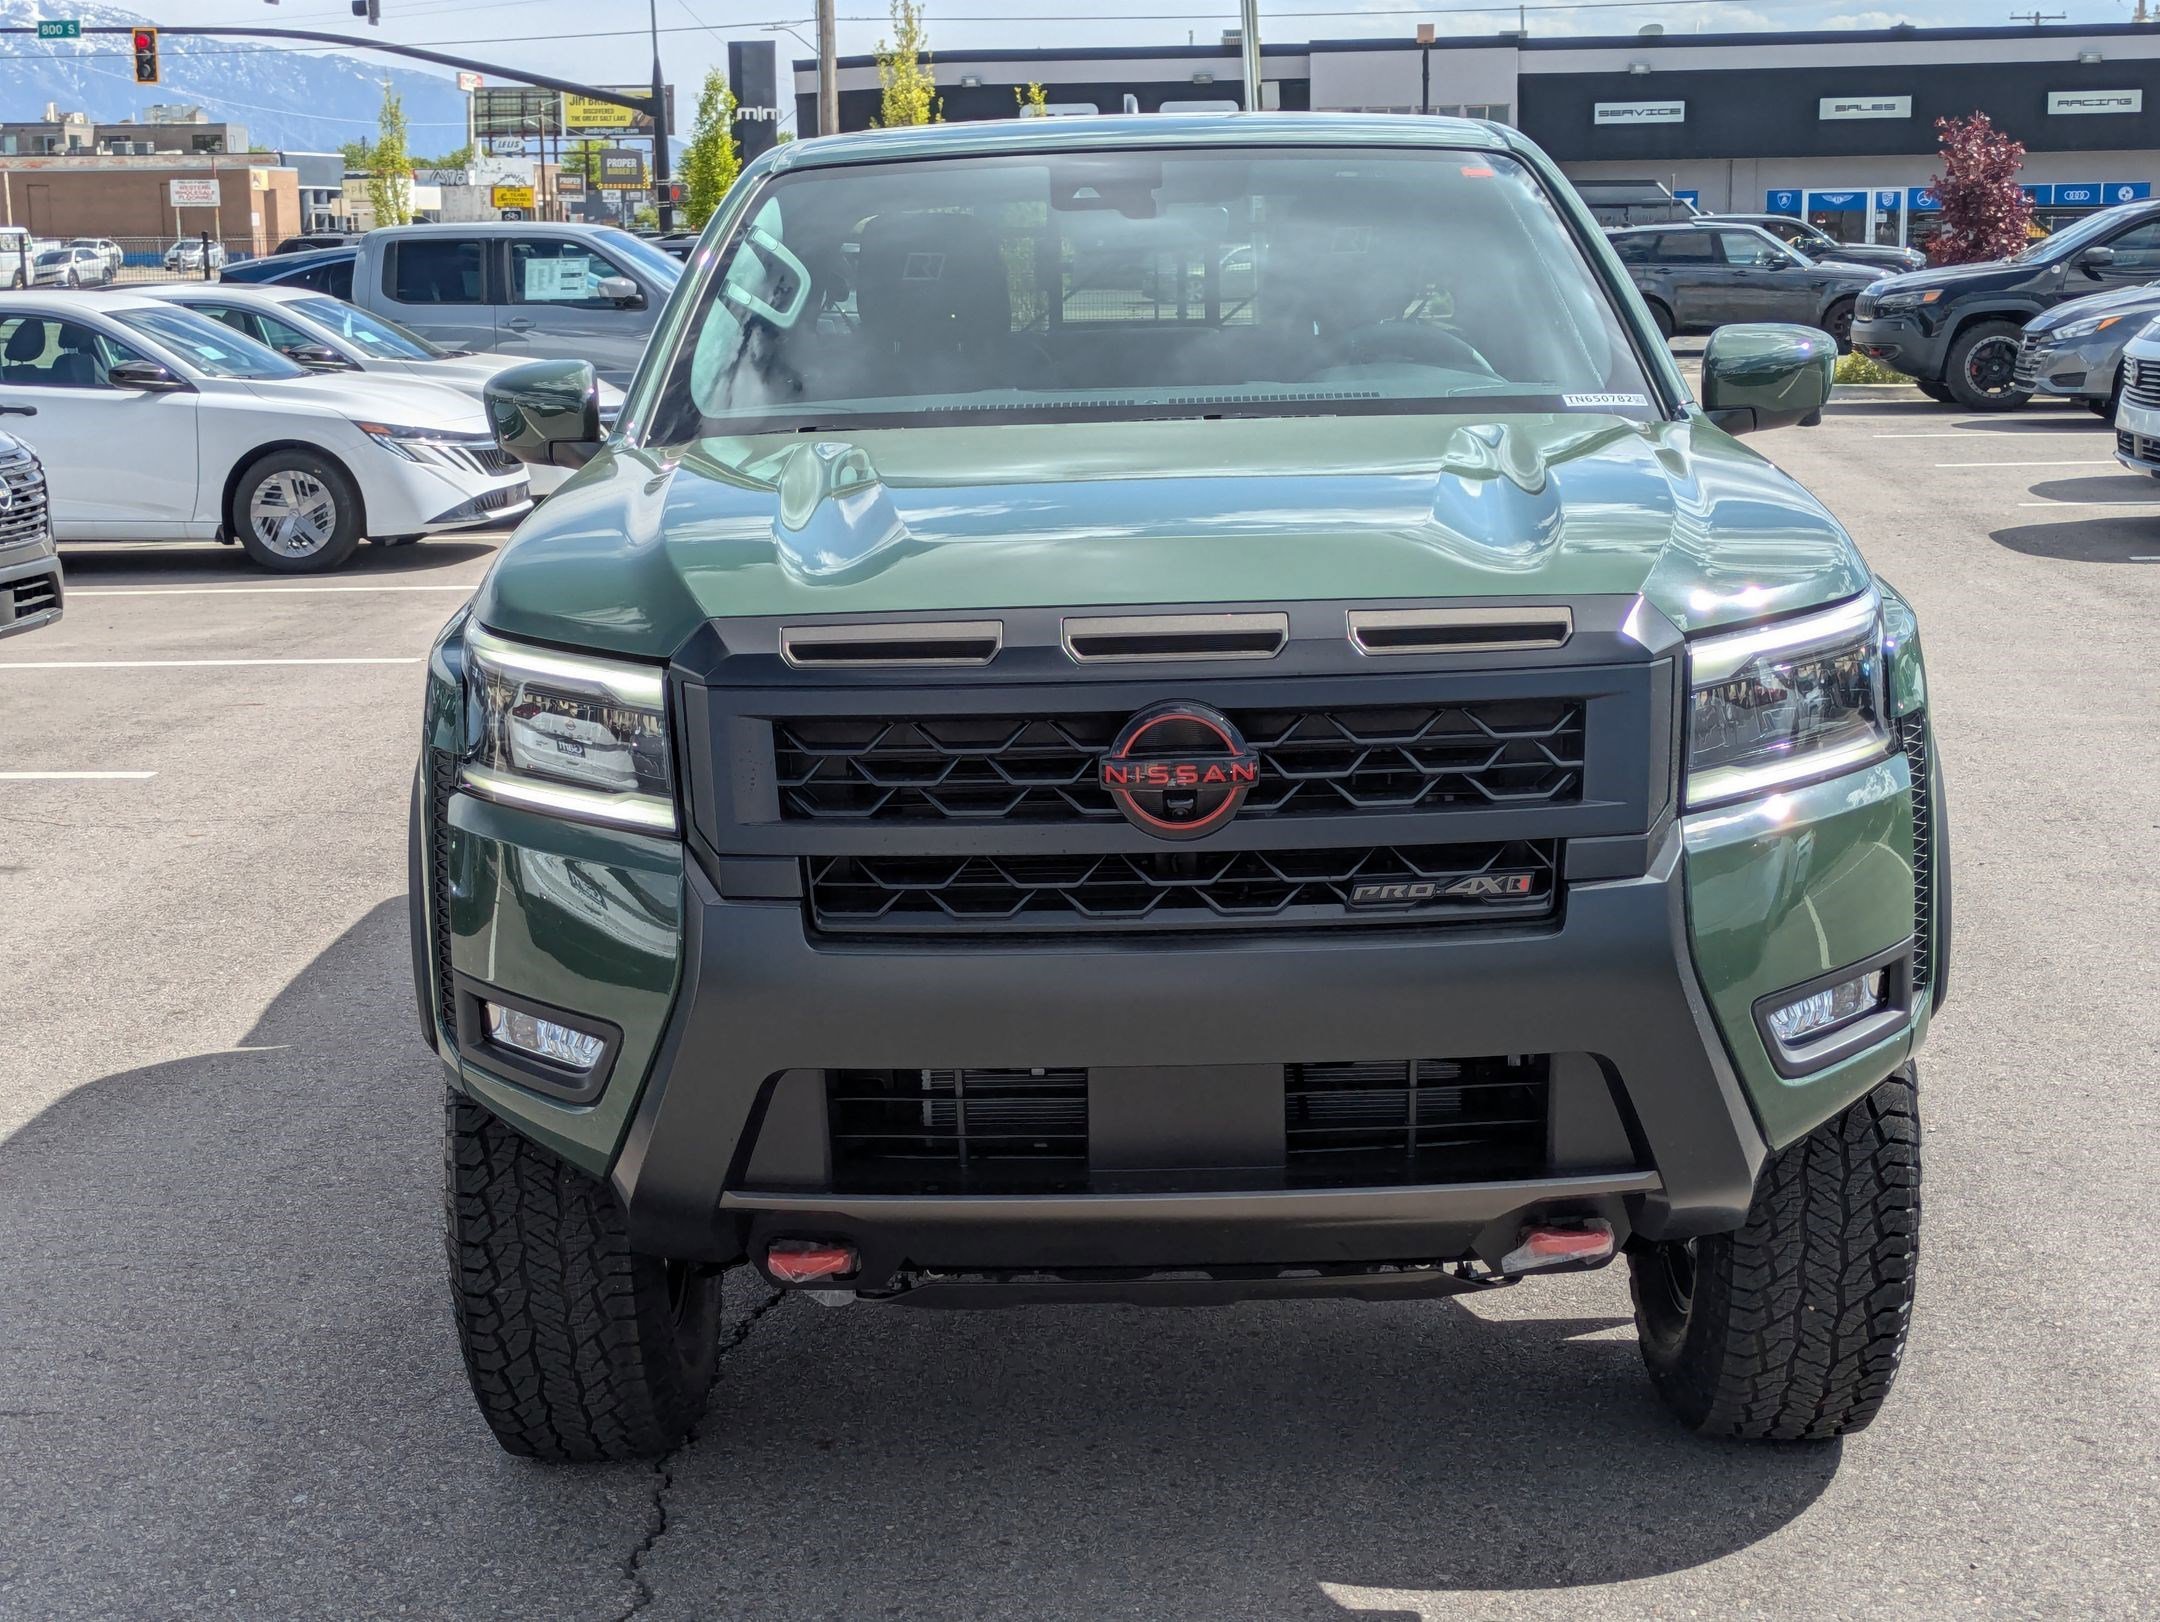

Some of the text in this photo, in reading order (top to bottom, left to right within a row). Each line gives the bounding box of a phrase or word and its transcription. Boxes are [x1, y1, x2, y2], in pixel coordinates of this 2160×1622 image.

[41, 24, 63, 35] 800
[2057, 97, 2132, 107] RACING
[1598, 107, 1681, 117] SERVICE
[1834, 103, 1896, 112] SALES
[607, 158, 637, 168] PROPER
[560, 177, 582, 185] PROPER
[1567, 395, 1633, 403] TN650782
[1104, 762, 1255, 784] NISSAN
